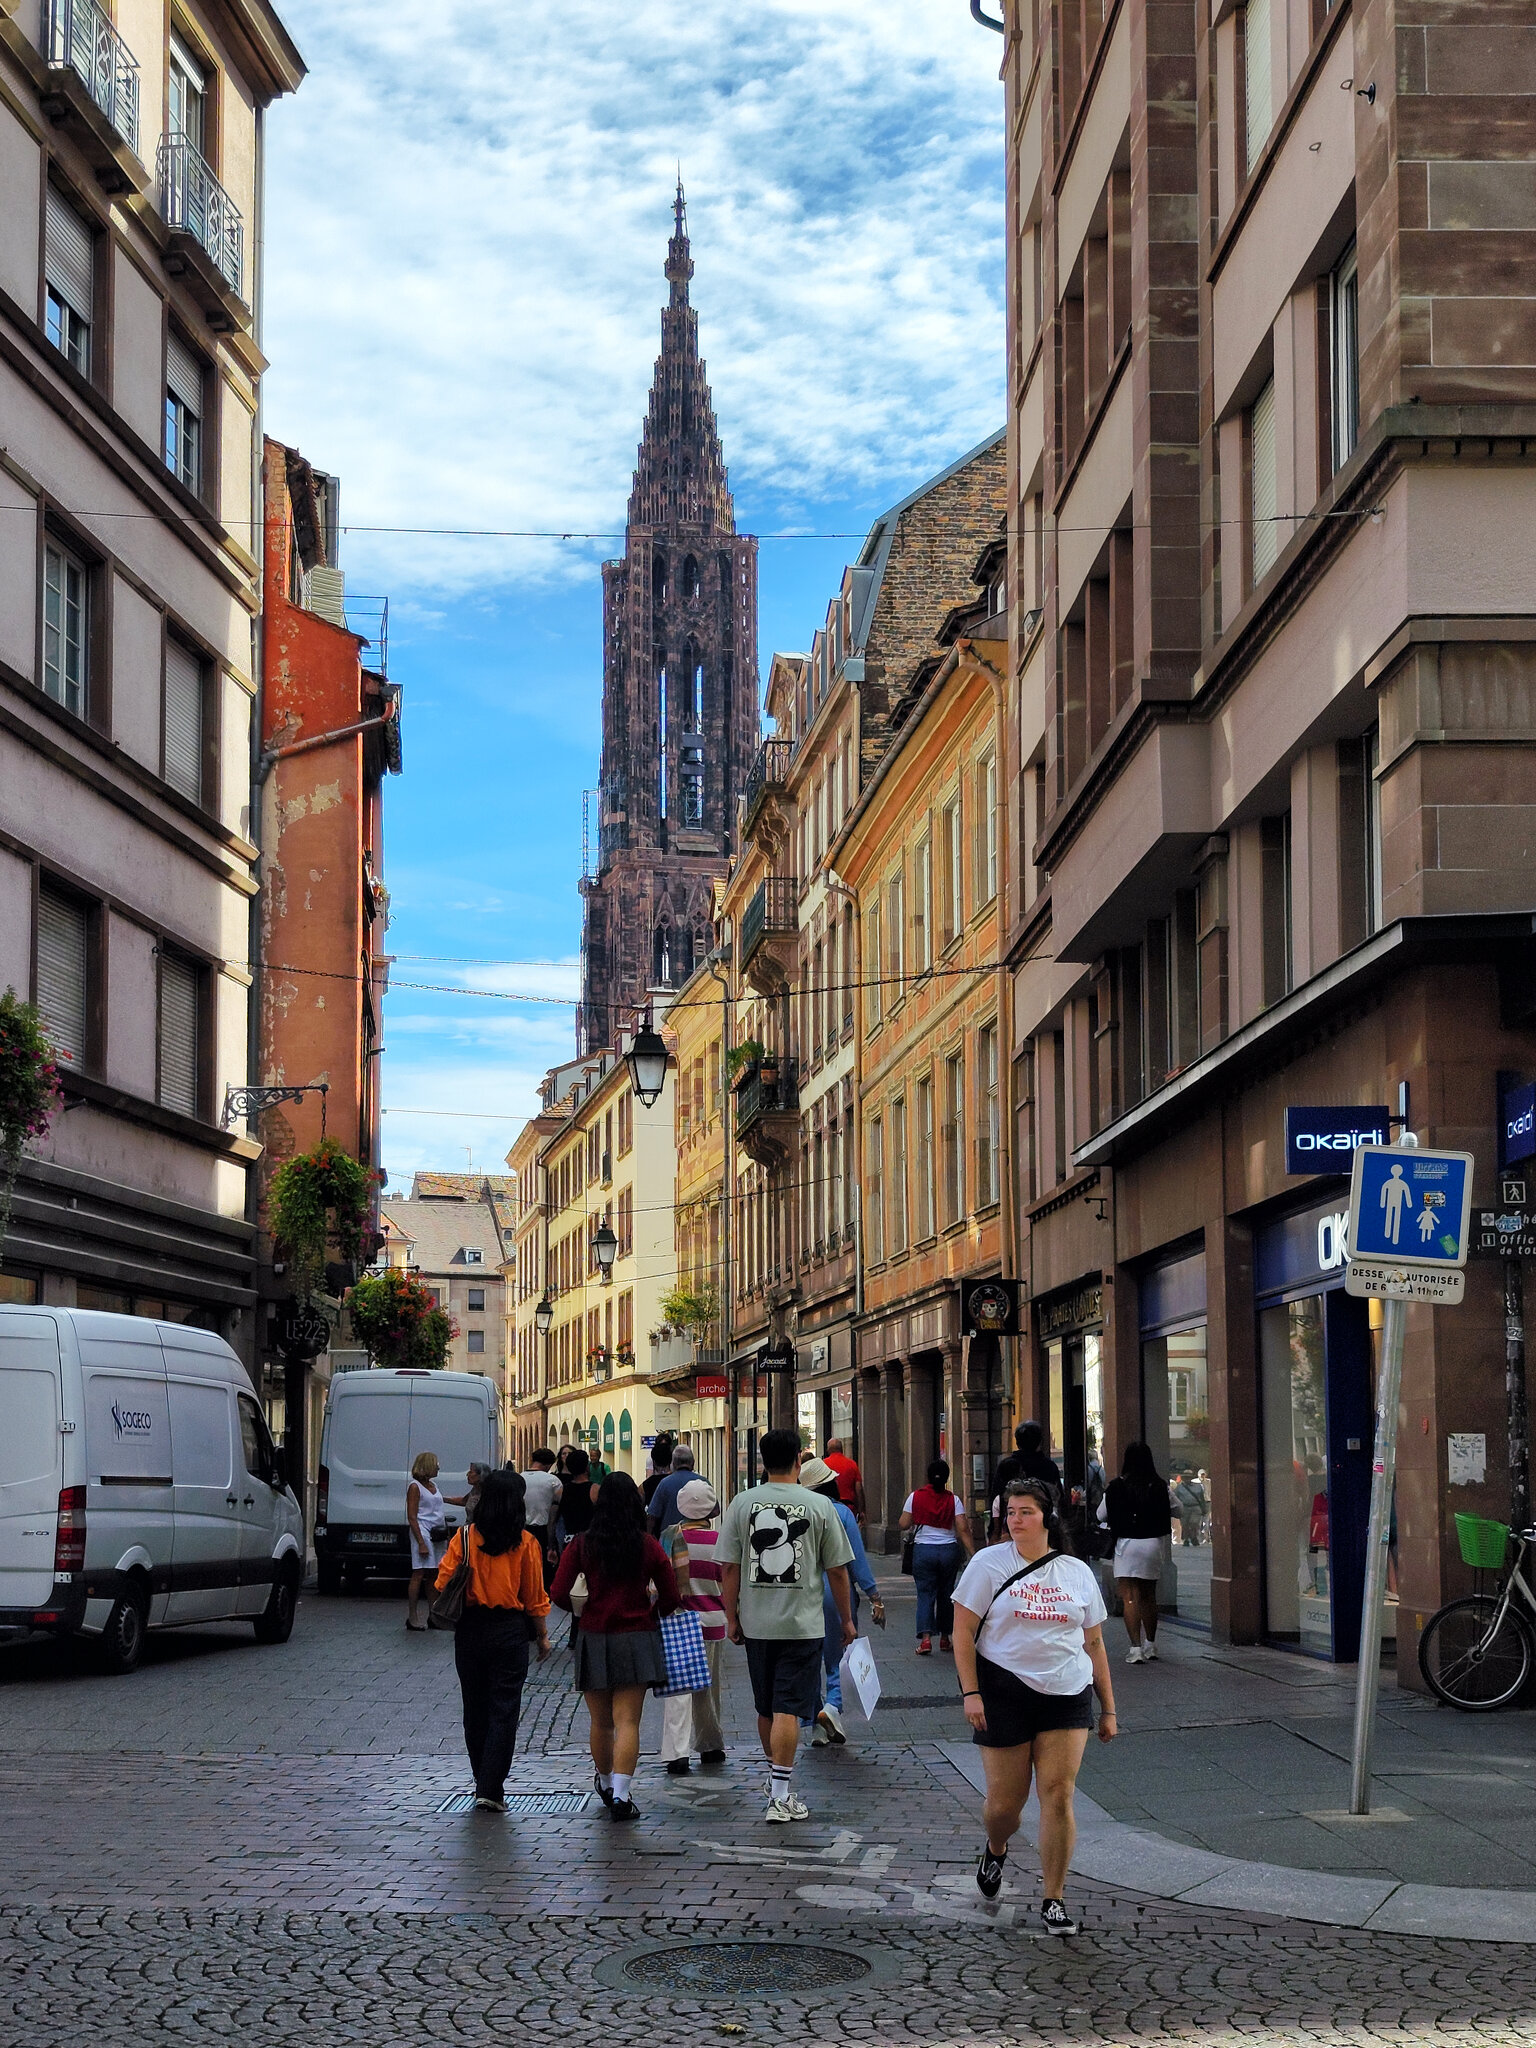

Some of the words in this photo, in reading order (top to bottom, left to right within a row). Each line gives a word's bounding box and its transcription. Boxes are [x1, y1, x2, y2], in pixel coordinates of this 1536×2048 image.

[1500, 1246, 1512, 1255] de
[1406, 1273, 1460, 1286] AUTORISÉE
[1365, 1282, 1378, 1291] DE
[699, 1385, 726, 1394] arche
[122, 1411, 152, 1429] SOGECO
[751, 1502, 806, 1517] PDA
[1009, 1588, 1038, 1603] what
[1041, 1593, 1075, 1604] book
[1042, 1586, 1062, 1595] me
[1026, 1601, 1032, 1611] I
[1035, 1604, 1057, 1612] am
[1014, 1610, 1069, 1623] reading
